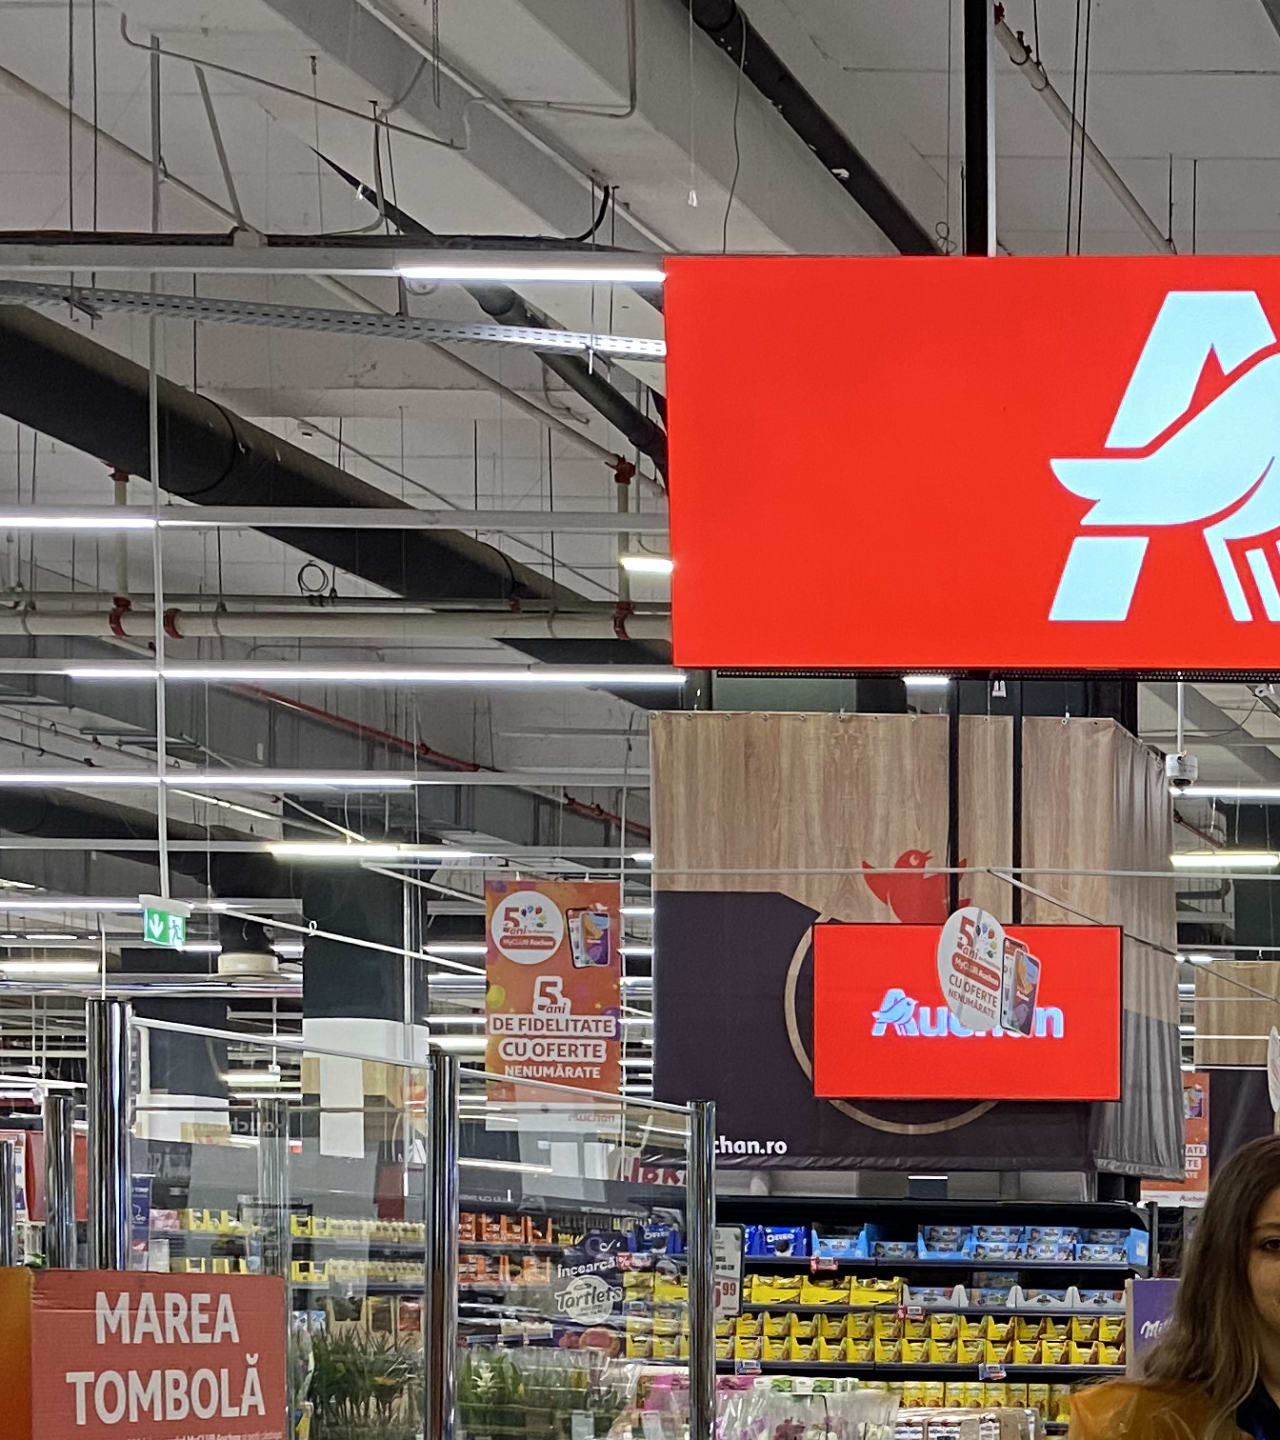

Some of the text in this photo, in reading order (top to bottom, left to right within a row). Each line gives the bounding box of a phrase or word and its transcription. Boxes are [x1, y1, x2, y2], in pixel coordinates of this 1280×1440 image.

[504, 907, 519, 933] 5
[957, 916, 975, 950] 5
[538, 981, 567, 1014] 5 ani
[948, 989, 995, 1019] NENUMĂRATE
[949, 974, 999, 1008] CU OFERTE
[493, 1018, 613, 1033] DE FIDELITATE
[871, 988, 1064, 1038] Aun
[502, 1042, 603, 1058] CU OFERTE
[505, 1063, 601, 1078] NENUMĂRATE
[713, 1136, 788, 1154] chan.ro
[722, 1282, 737, 1296] 99
[95, 1291, 240, 1345] MAREA
[66, 1352, 266, 1426] TOMBOLĂ
